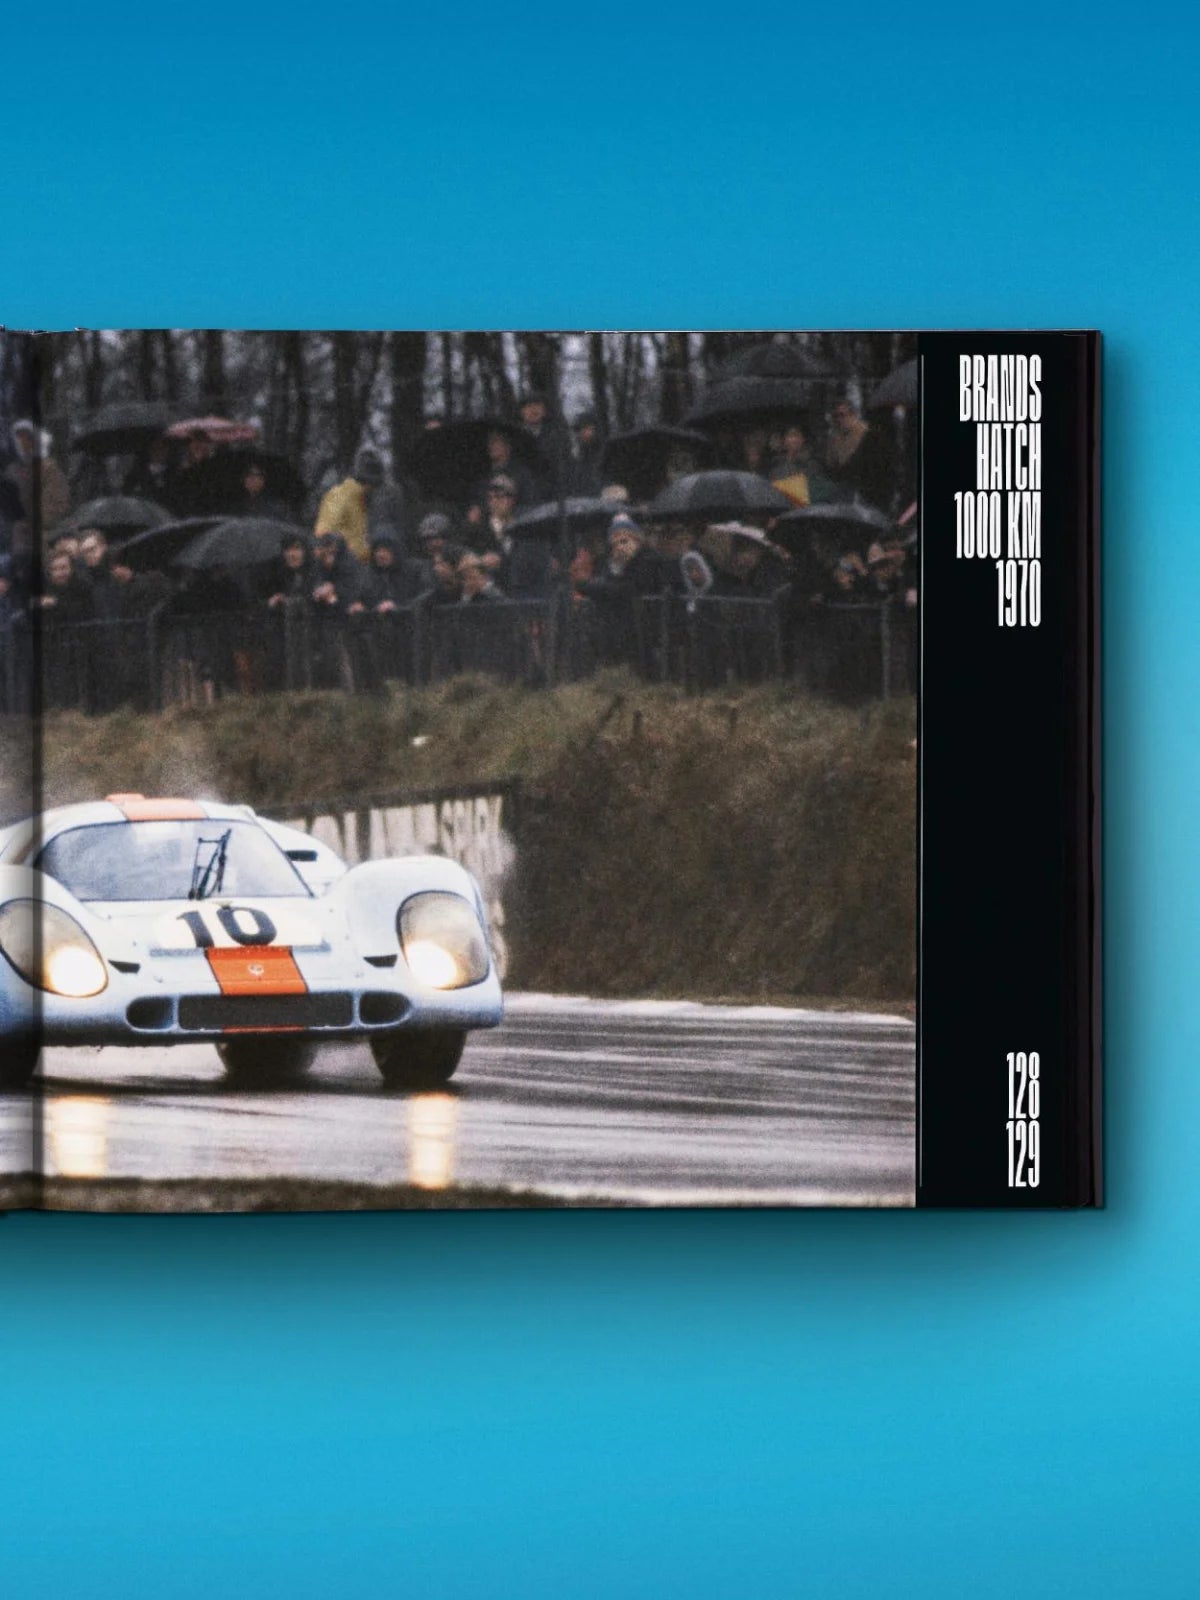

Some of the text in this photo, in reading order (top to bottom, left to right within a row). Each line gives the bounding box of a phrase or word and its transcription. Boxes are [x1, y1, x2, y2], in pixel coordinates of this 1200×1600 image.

[959, 354, 1042, 422] BRANDS
[976, 423, 1042, 490] HATCH
[954, 491, 1042, 559] 1000 KM
[995, 559, 1042, 627] 1970
[176, 905, 278, 948] 10
[1006, 1052, 1040, 1120] 128
[1006, 1120, 1040, 1188] 129
